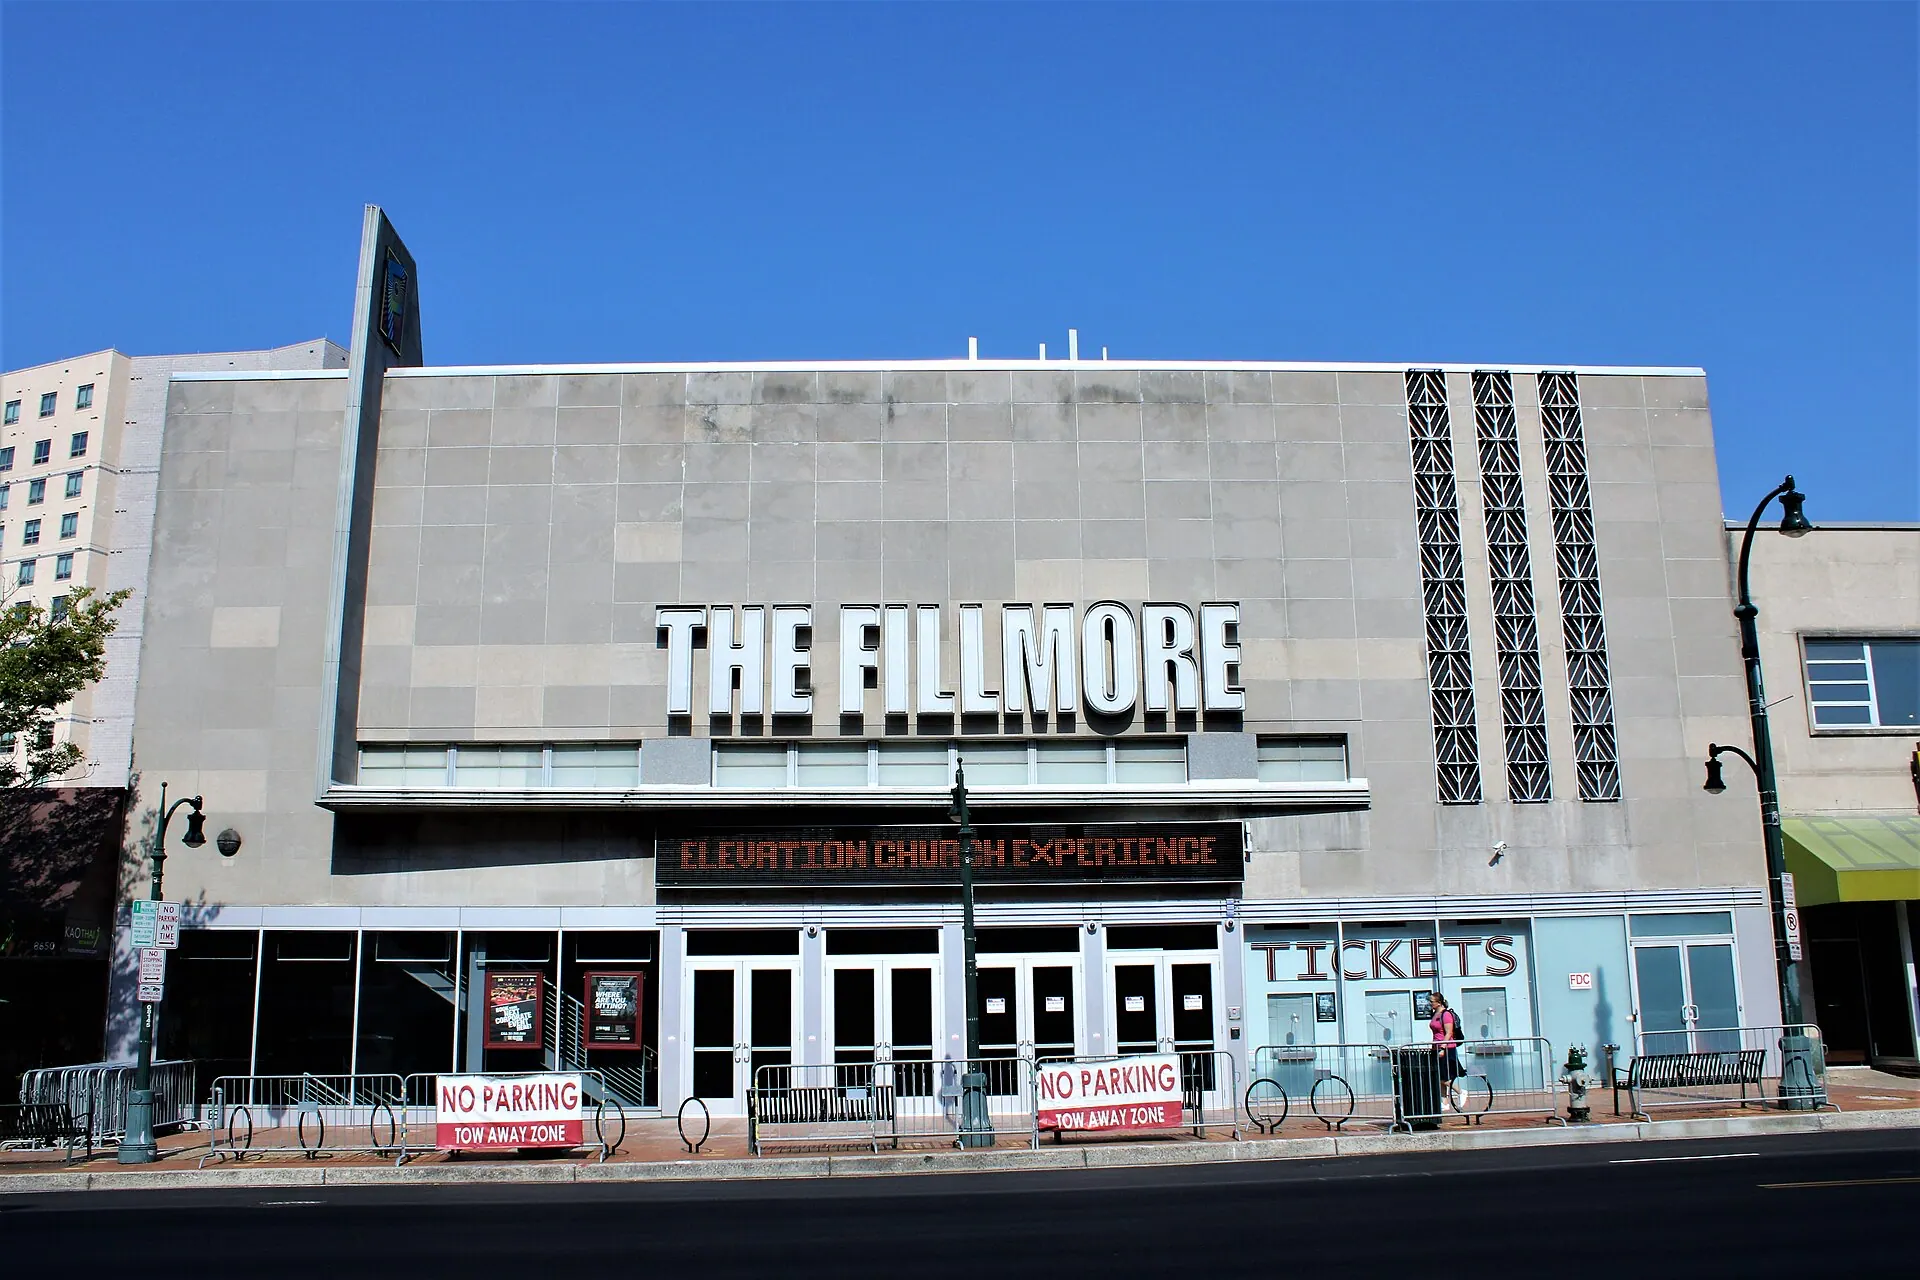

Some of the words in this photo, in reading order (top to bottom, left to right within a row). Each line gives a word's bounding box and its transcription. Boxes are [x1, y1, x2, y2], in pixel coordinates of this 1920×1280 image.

[656, 602, 813, 716] THE
[840, 600, 1246, 716] FILLMORE
[680, 840, 867, 869] ELEVATION
[1012, 836, 1217, 867] EXPERIENCE
[158, 914, 178, 923] PARKING
[1250, 935, 1518, 982] TICKETS
[1570, 974, 1590, 985] FDC
[1040, 1071, 1073, 1099] NO
[1081, 1064, 1175, 1097] PARKING
[442, 1085, 475, 1112] NO
[484, 1082, 578, 1112] PARKING
[1056, 1112, 1085, 1129] TOW
[1088, 1108, 1127, 1127] AWAY
[1130, 1106, 1165, 1124] ZONE
[454, 1127, 484, 1144] TOW
[488, 1126, 528, 1143] AWAY
[530, 1124, 565, 1142] ZONE
